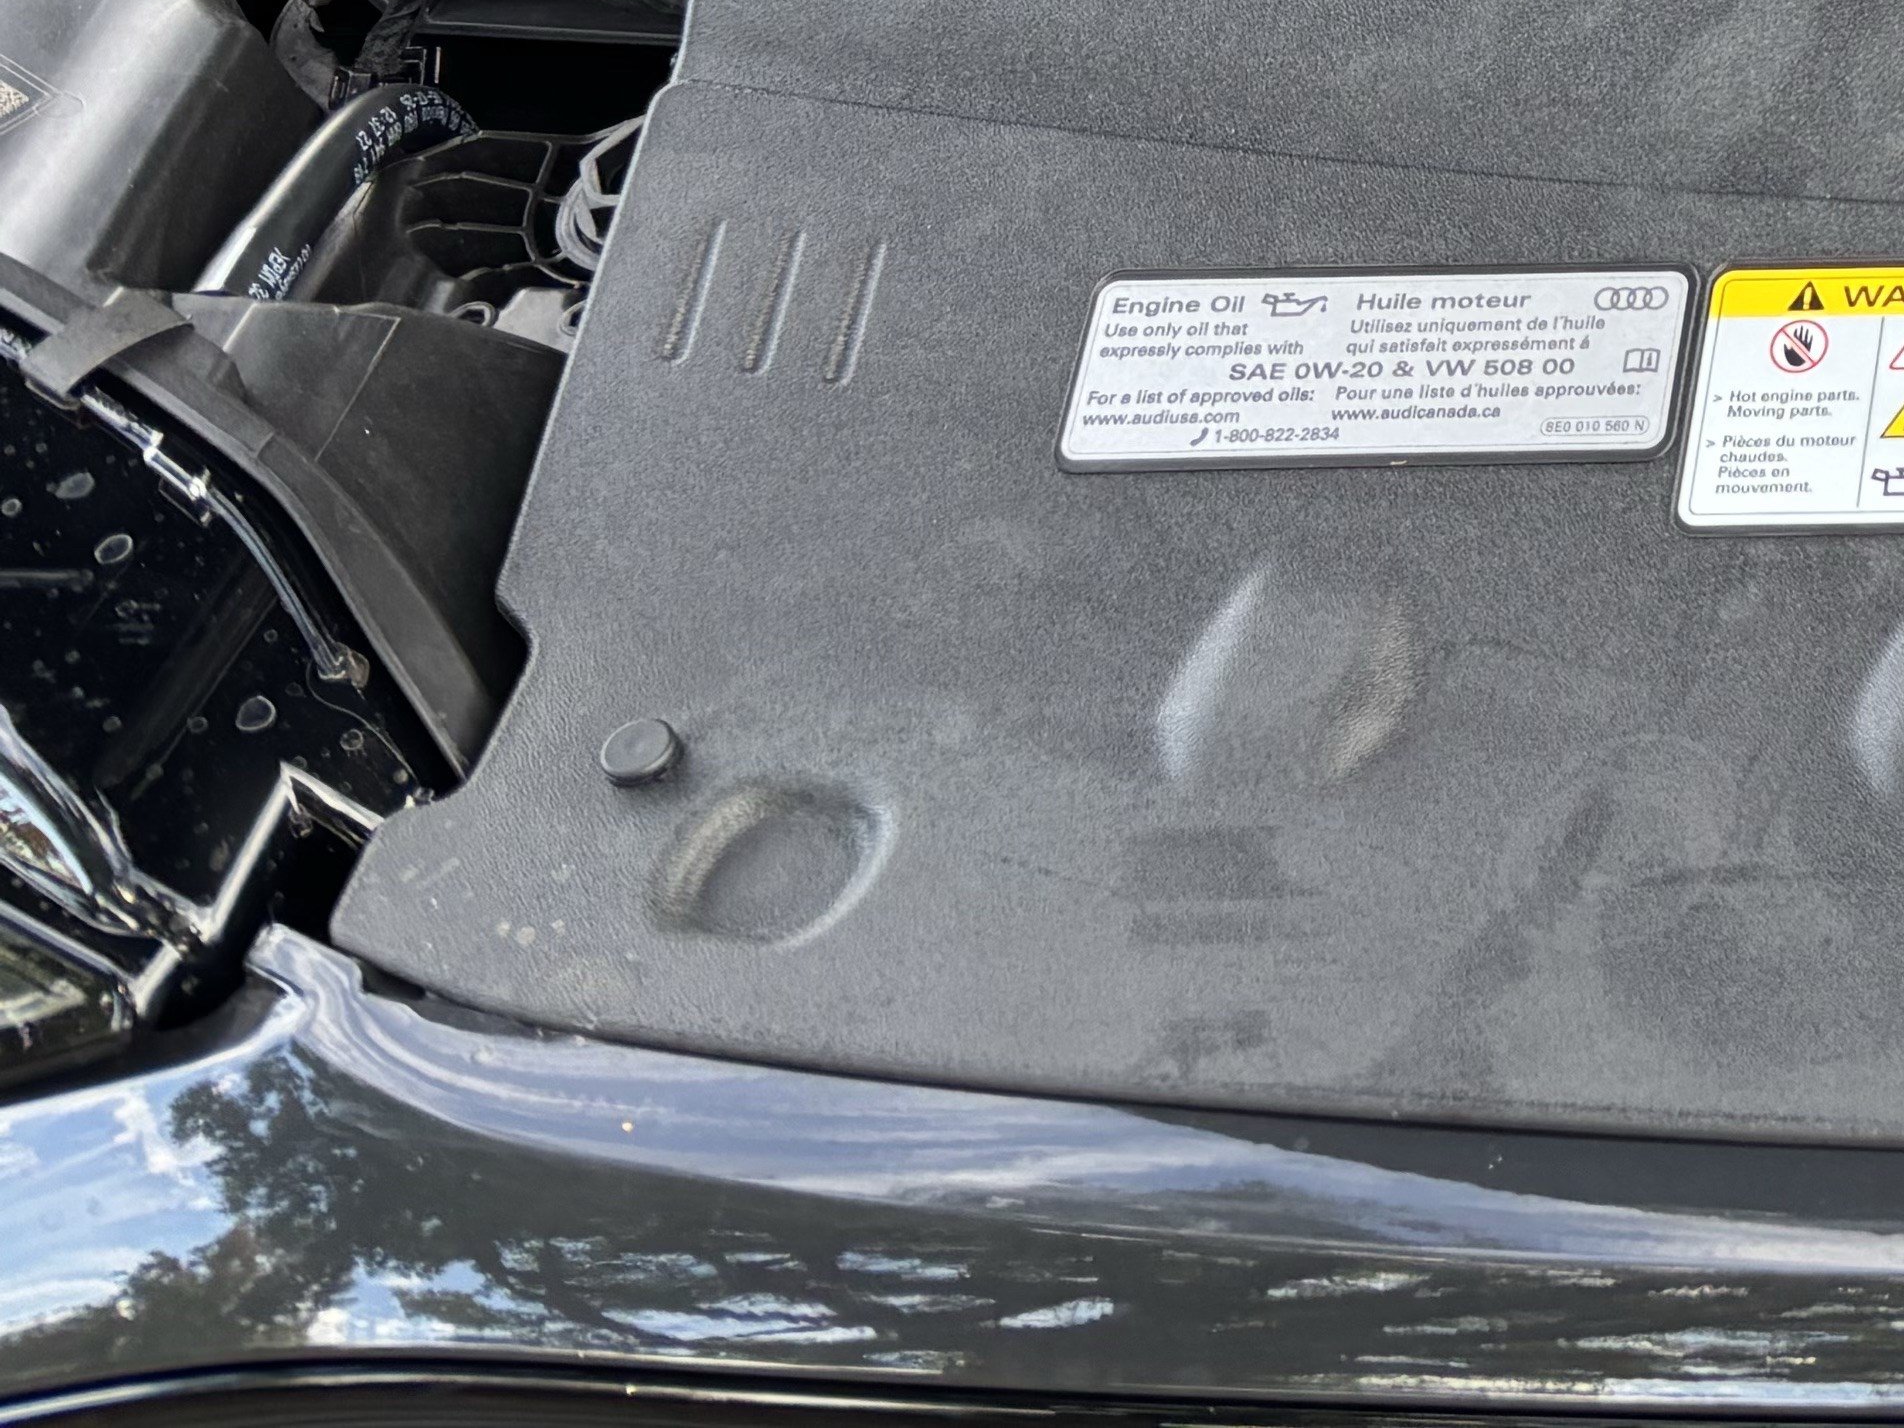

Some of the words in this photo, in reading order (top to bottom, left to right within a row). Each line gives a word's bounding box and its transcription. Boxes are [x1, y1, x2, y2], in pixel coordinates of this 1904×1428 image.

[1113, 297, 1200, 316] Engine
[1211, 296, 1245, 313] Oil
[1357, 294, 1422, 311] Huile
[1431, 294, 1531, 310] moteur
[1104, 324, 1138, 337] Use
[1144, 323, 1181, 338] only
[1187, 322, 1208, 336] oil
[1214, 322, 1248, 336] that
[1350, 319, 1411, 334] Utilisez
[1418, 318, 1521, 334] uniquement
[1527, 318, 1547, 331] de
[1553, 316, 1605, 331] l'huile
[1100, 343, 1181, 359] expressly
[1185, 342, 1261, 359] complies
[1268, 341, 1303, 355] with
[1346, 341, 1373, 355] qui
[1380, 338, 1446, 353] satisfait
[1452, 336, 1574, 354] expressément
[1229, 363, 1286, 380] SAE
[1294, 360, 1384, 380] 0W-20
[1392, 360, 1414, 377] &
[1426, 359, 1476, 377] VW
[1484, 359, 1533, 376] 508
[1542, 358, 1574, 375] 00
[1088, 391, 1116, 405] For
[1120, 394, 1131, 404] a
[1136, 389, 1169, 404] list
[1174, 389, 1188, 403] of
[1190, 388, 1272, 405] approved
[1278, 388, 1315, 401] oils:
[1335, 385, 1376, 400] Pour
[1381, 387, 1413, 399] une
[1419, 384, 1454, 399] liste
[1461, 383, 1529, 398] d'huiles
[1535, 381, 1641, 399] approuvées:
[1730, 391, 1756, 402] Hot
[1761, 389, 1812, 403] engine
[1817, 390, 1859, 403] parts.
[1082, 410, 1239, 425] www.audiusa.com
[1331, 406, 1501, 421] www.audicanada.ca
[1727, 405, 1785, 419] Moving
[1790, 406, 1832, 419] parts.
[1576, 421, 1600, 432] 010
[1635, 420, 1644, 431] N
[1215, 427, 1340, 443] 1-800-822-2834
[1776, 435, 1795, 447] du
[1800, 436, 1856, 447] moteur
[1720, 451, 1788, 463] chaudes.
[1771, 468, 1790, 477] en
[1715, 482, 1812, 493] mouvement.
